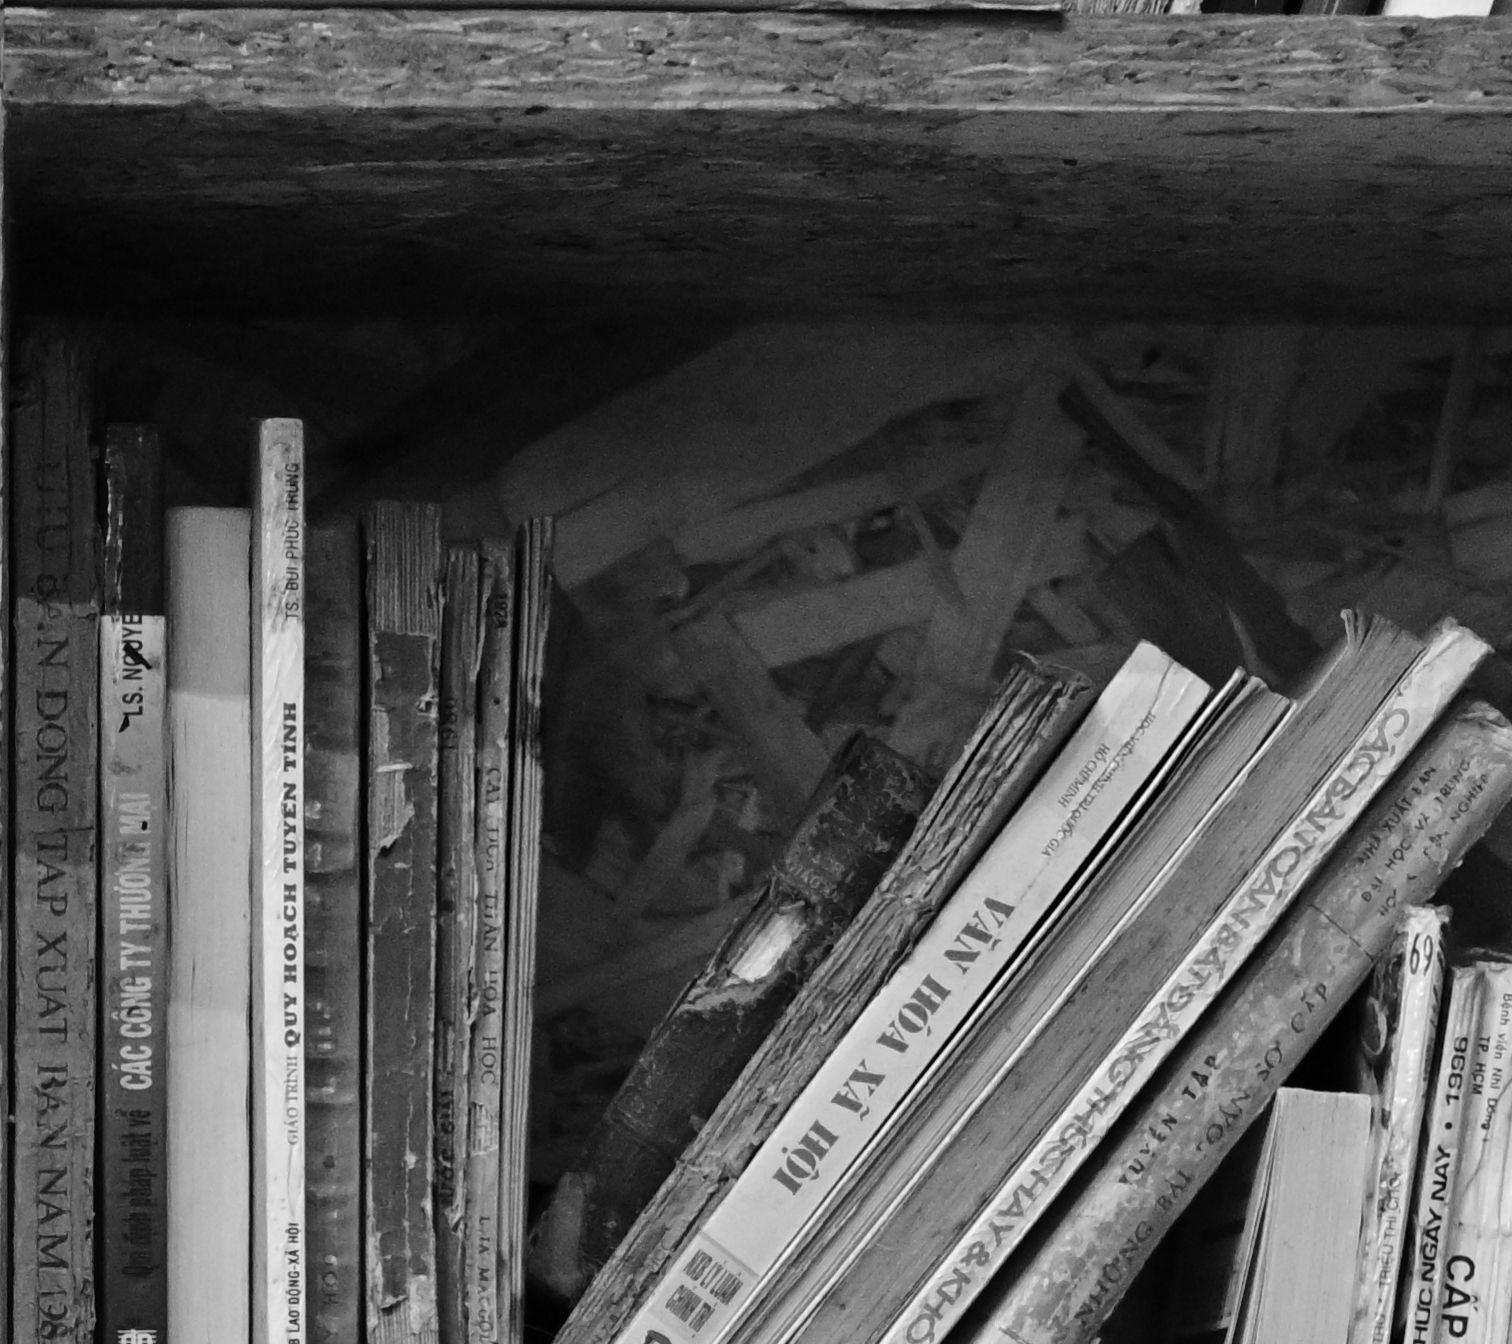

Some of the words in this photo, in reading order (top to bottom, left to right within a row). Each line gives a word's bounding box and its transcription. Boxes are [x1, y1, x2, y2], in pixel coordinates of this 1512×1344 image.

[944, 897, 1016, 975] VĂN
[876, 974, 951, 1053] HÓA
[831, 1059, 886, 1121] XÃ
[1431, 1145, 1451, 1205] NAY
[1445, 1036, 1469, 1105] 1996
[772, 1120, 839, 1195] HỘI
[1437, 1253, 1484, 1341] CẤP
